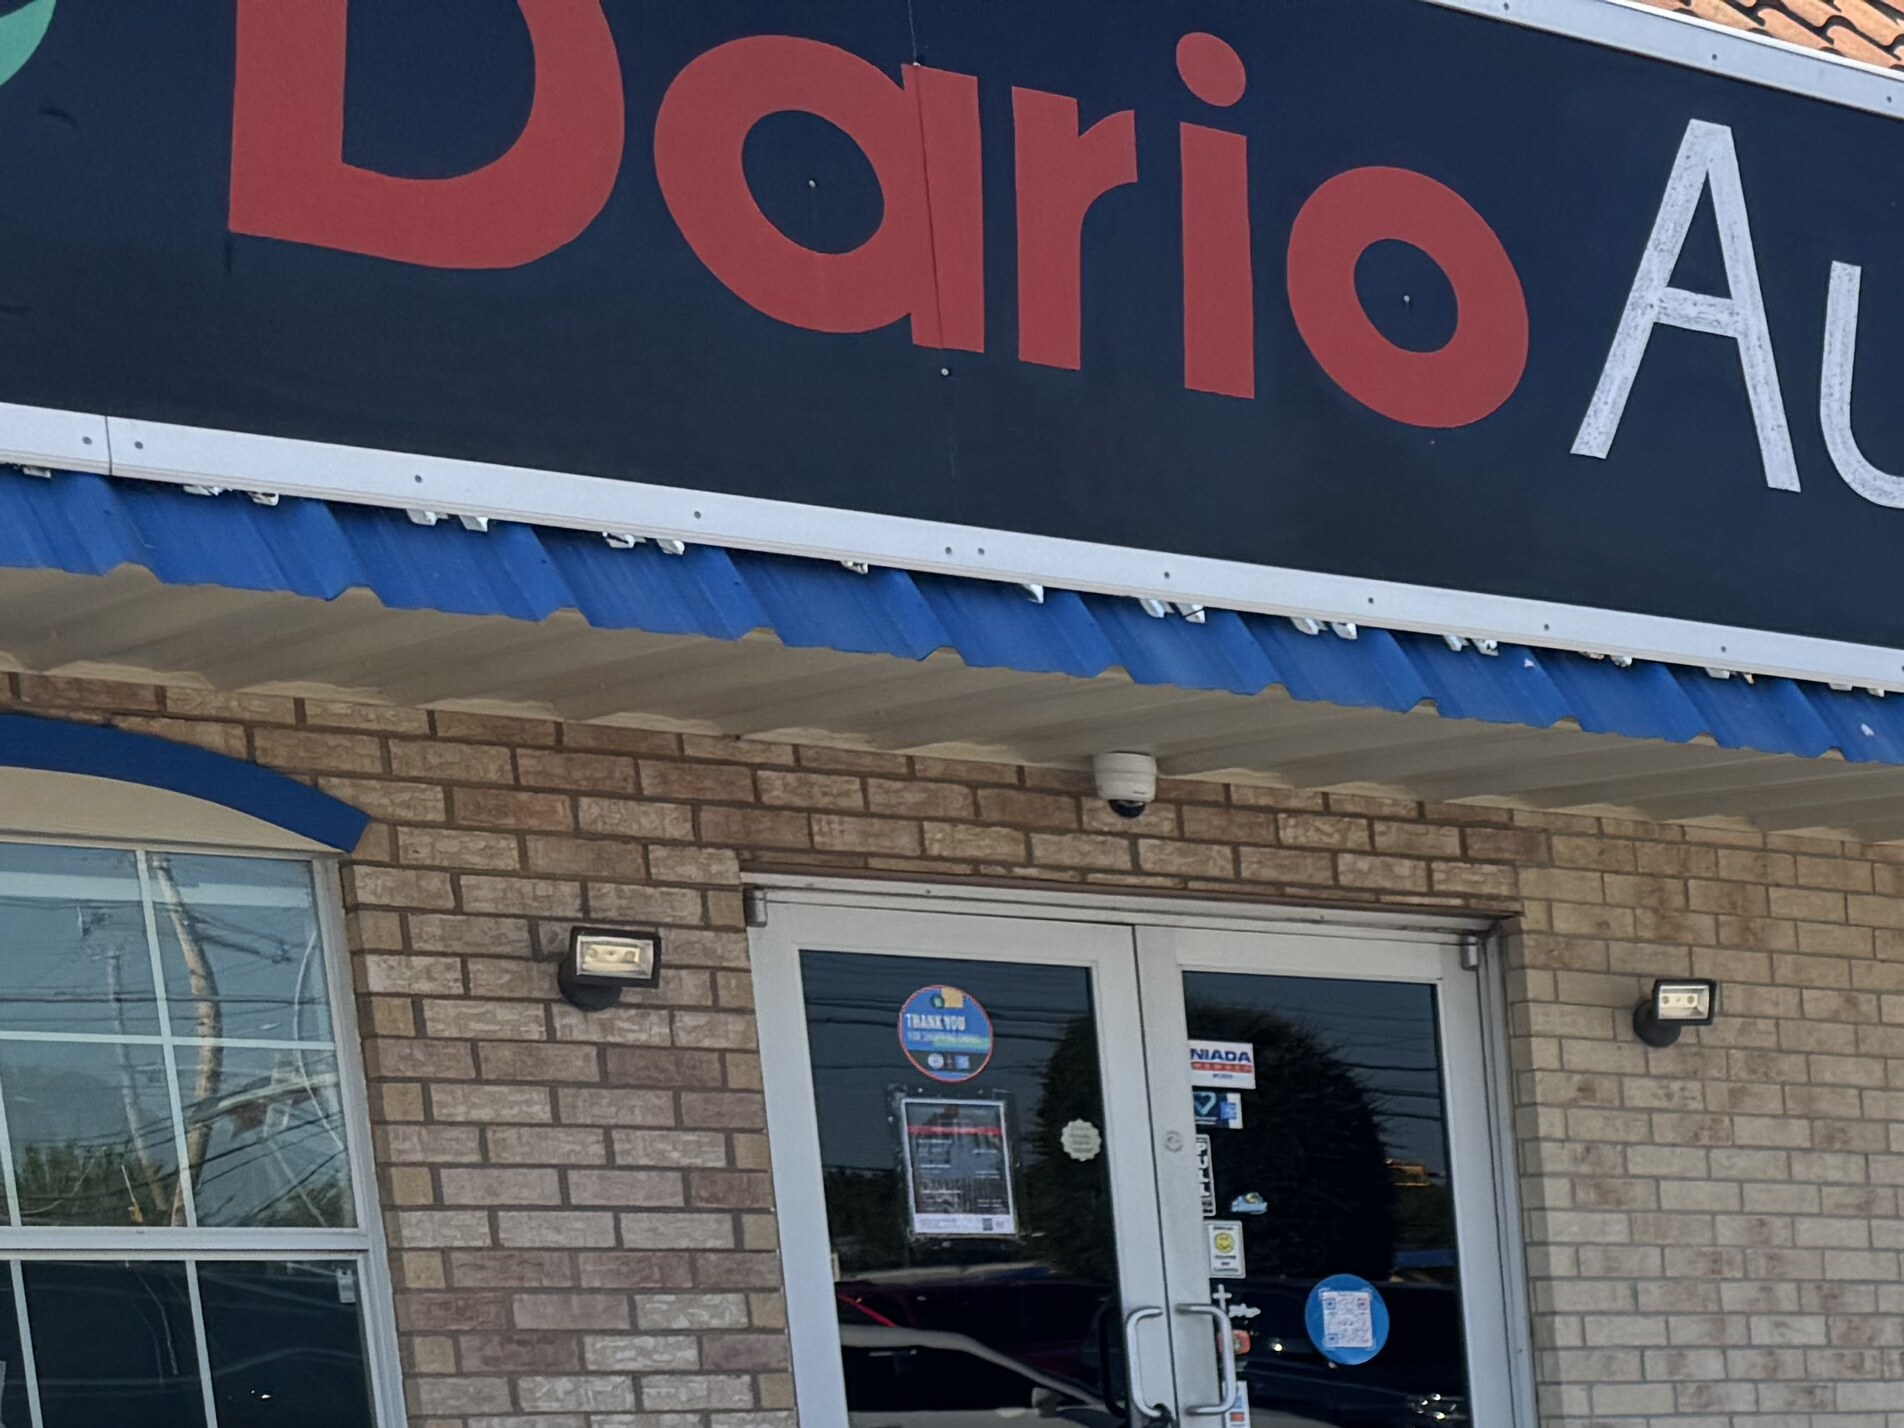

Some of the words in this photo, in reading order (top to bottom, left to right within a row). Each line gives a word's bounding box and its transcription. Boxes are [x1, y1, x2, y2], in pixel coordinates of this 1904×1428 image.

[228, 0, 1530, 429] Dario
[905, 1013, 944, 1030] THANK
[943, 1015, 966, 1032] YOU
[1190, 1047, 1252, 1063] NIADA
